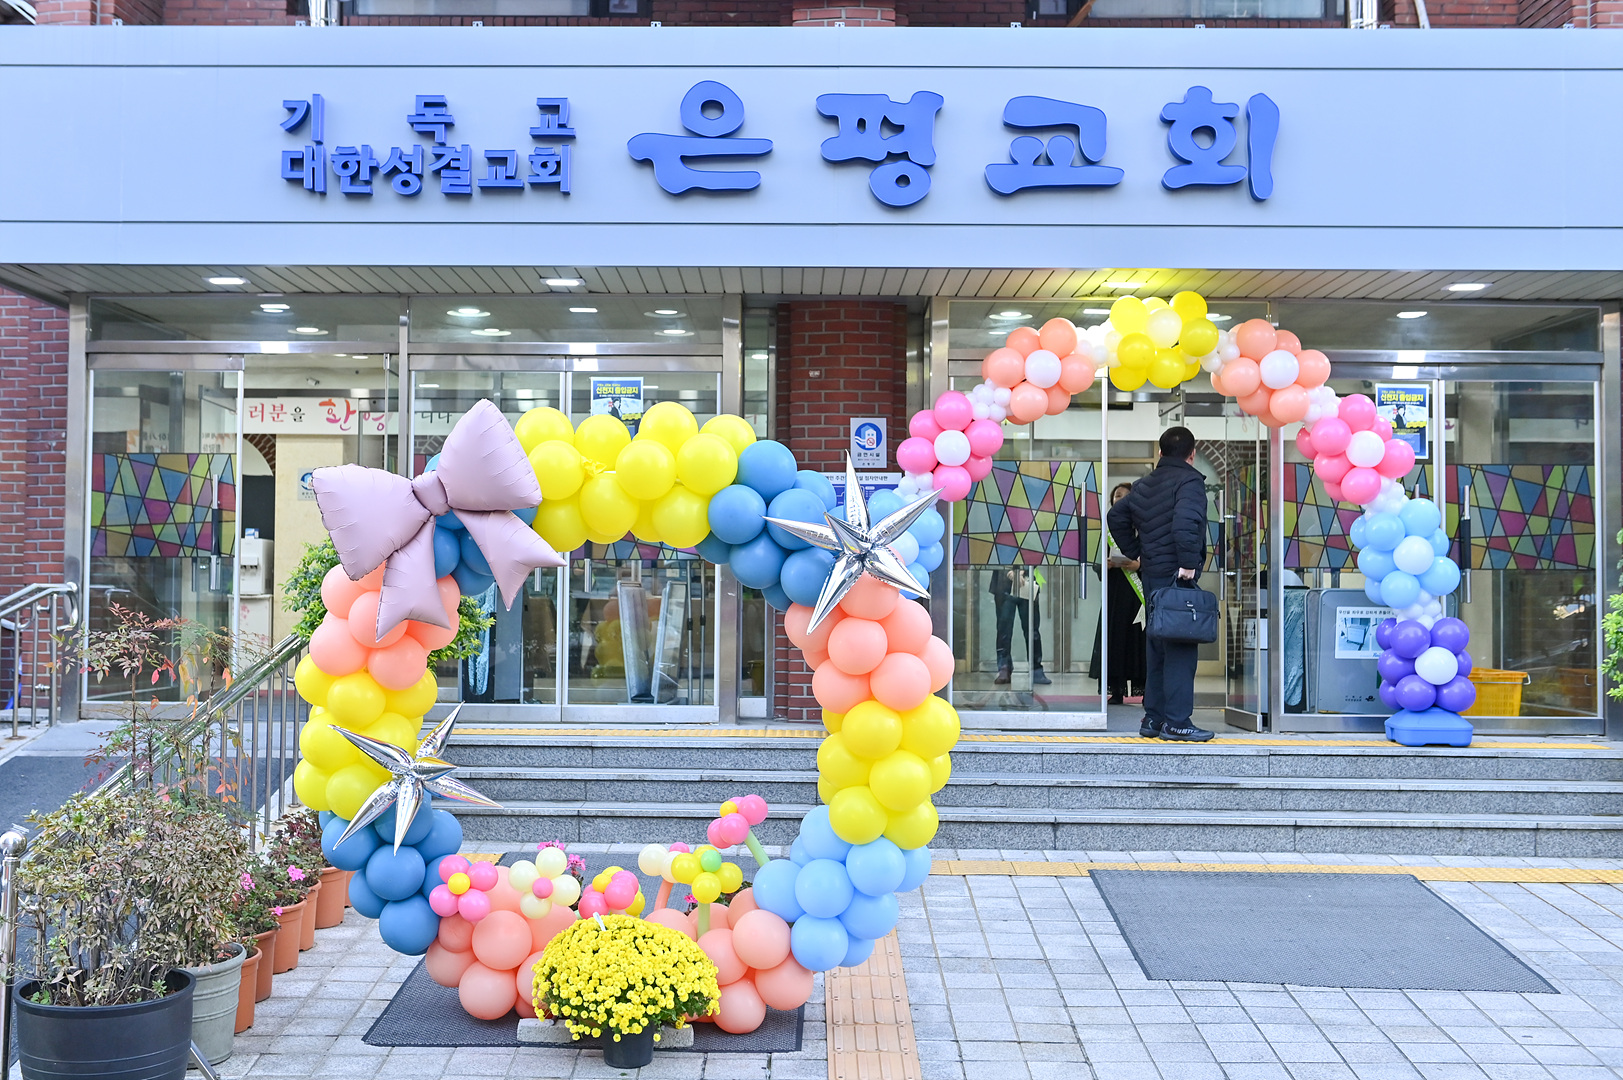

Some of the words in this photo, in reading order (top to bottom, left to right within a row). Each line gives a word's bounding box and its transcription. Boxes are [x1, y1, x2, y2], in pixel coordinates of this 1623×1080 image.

[281, 144, 571, 195] 대한성결교회
[627, 80, 1280, 209] 은평교회
[249, 402, 306, 423] 러분을
